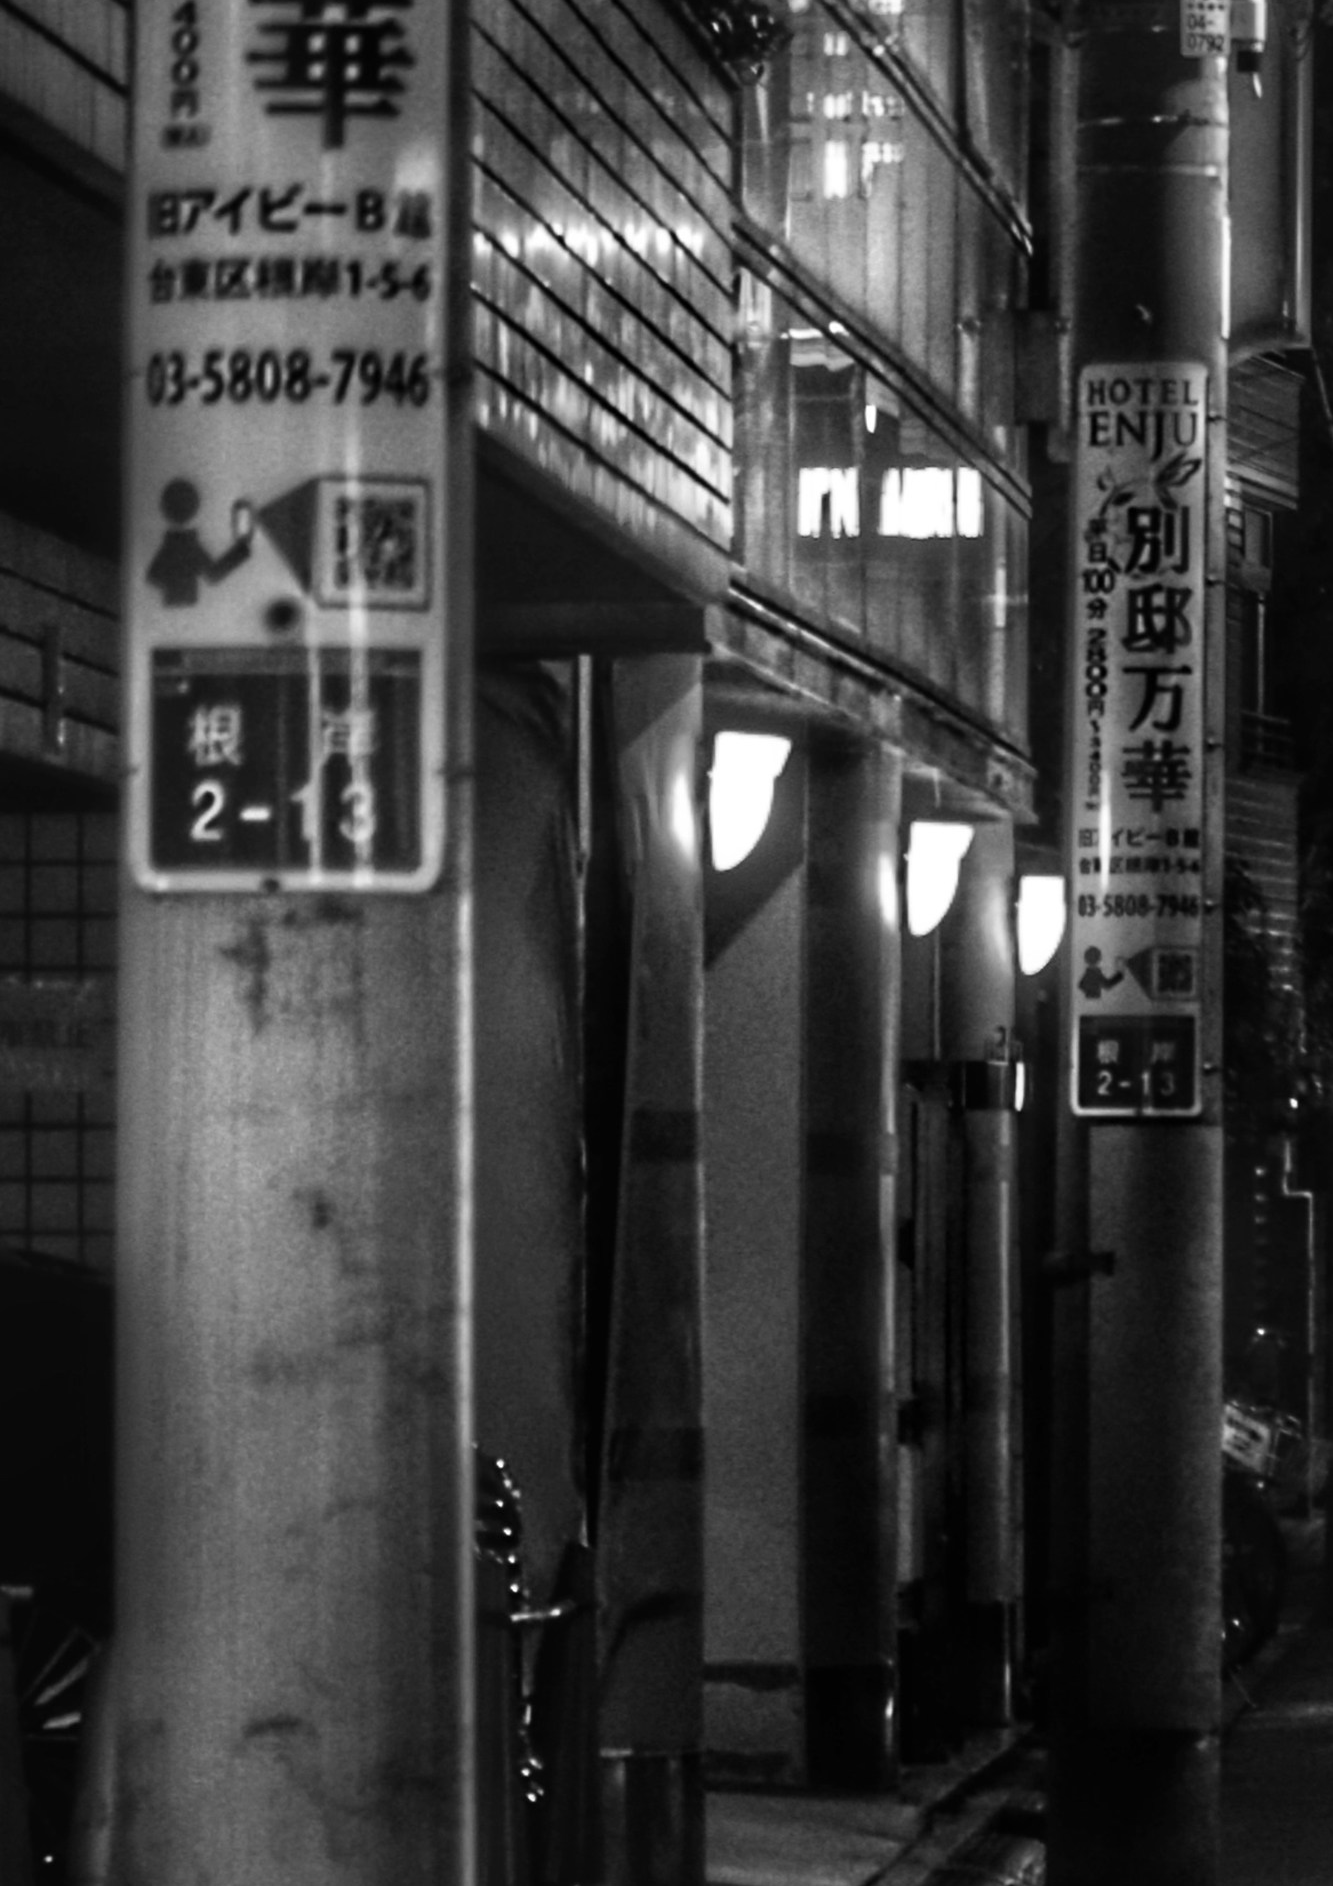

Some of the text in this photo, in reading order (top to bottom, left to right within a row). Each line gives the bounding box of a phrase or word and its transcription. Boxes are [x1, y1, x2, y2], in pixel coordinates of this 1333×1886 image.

[147, 348, 431, 408] 03-5808-7946
[1087, 378, 1199, 405] HOTEL
[1090, 411, 1198, 462] ENJU
[190, 782, 377, 842] 2-13
[1097, 1070, 1176, 1097] 2-13
